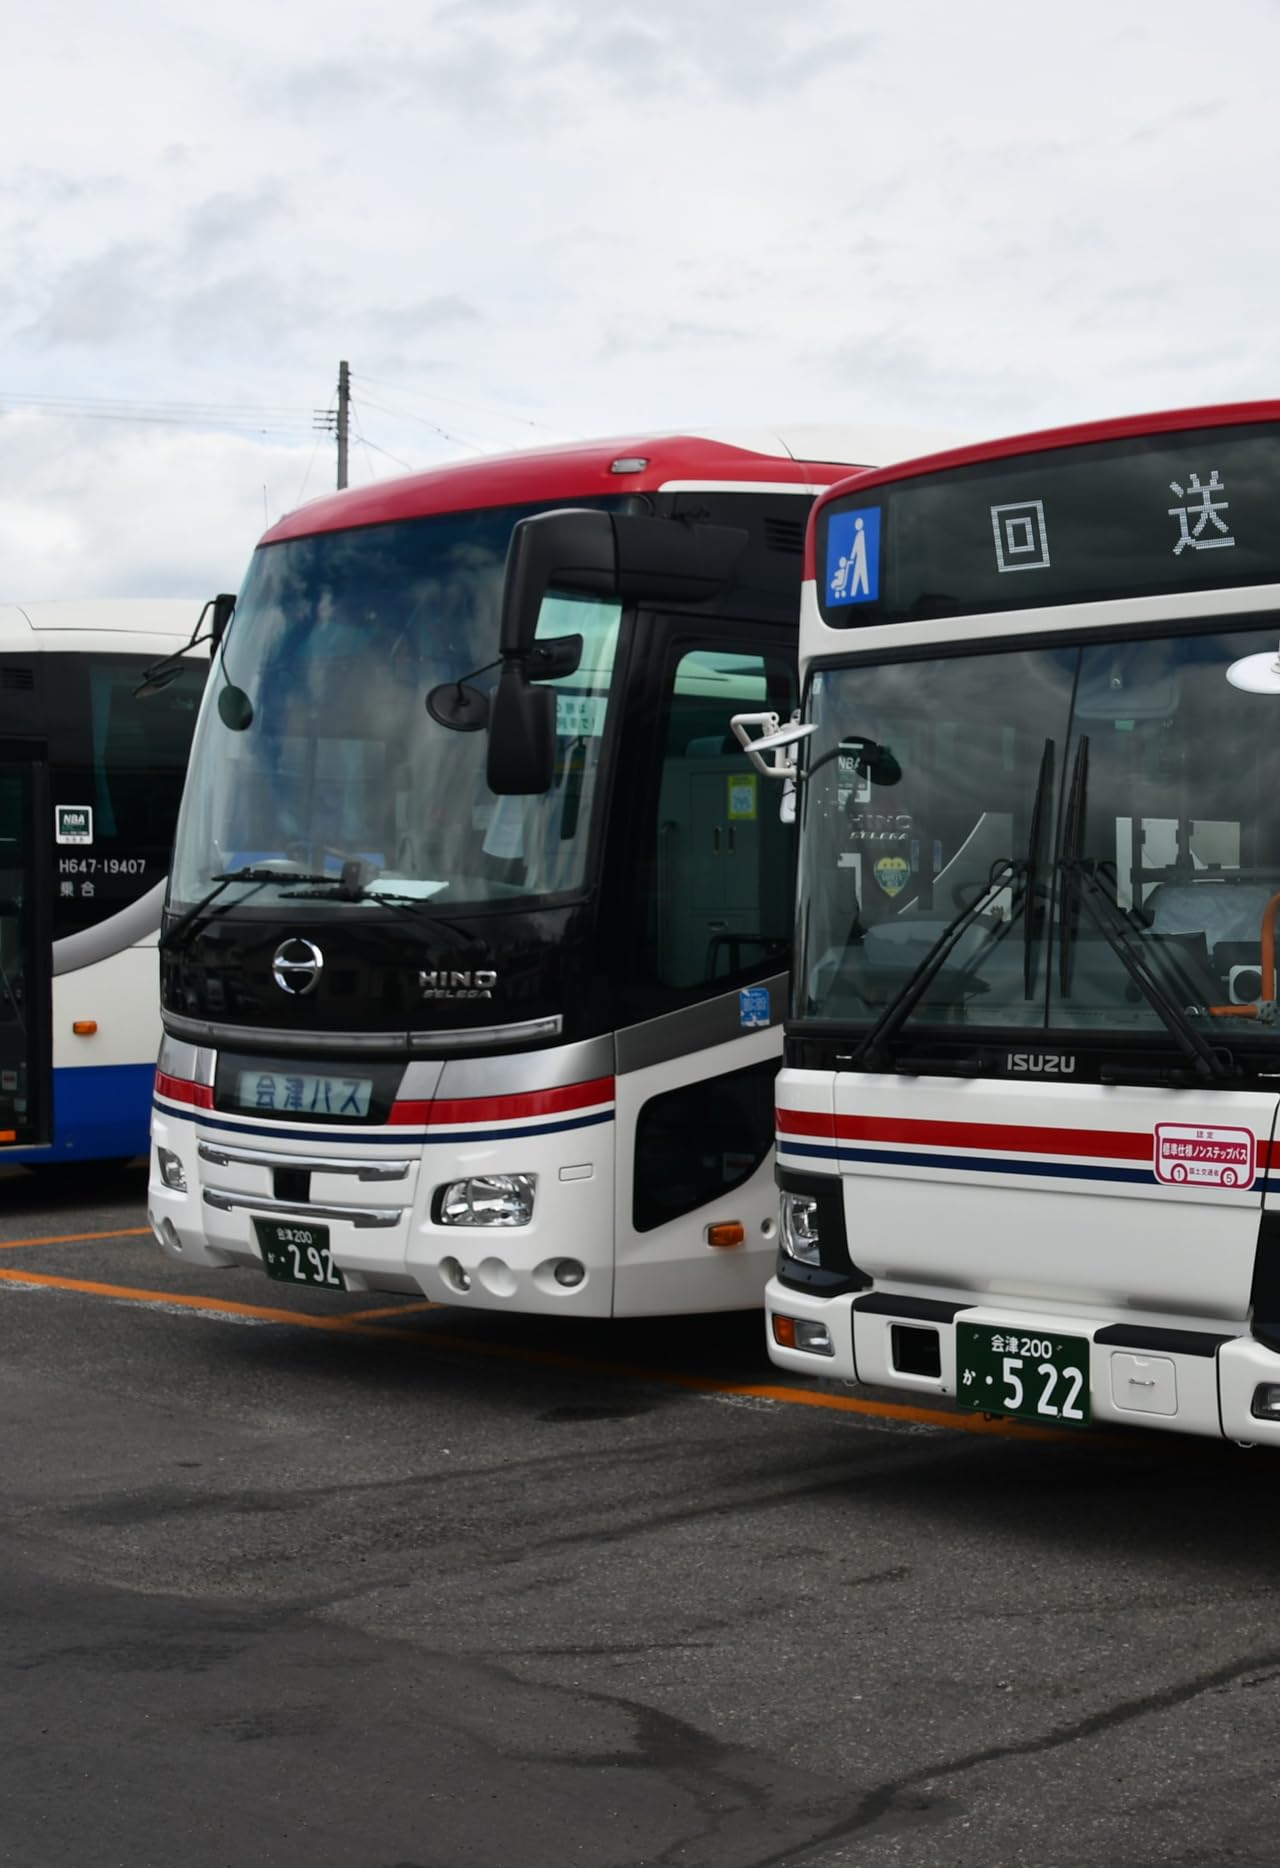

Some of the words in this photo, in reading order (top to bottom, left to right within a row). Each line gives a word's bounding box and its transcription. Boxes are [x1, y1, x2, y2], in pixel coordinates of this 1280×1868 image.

[59, 859, 146, 873] H647-19407
[419, 970, 497, 988] HINO
[1007, 1053, 1076, 1073] ISUZU
[991, 1334, 1052, 1358] 会津200
